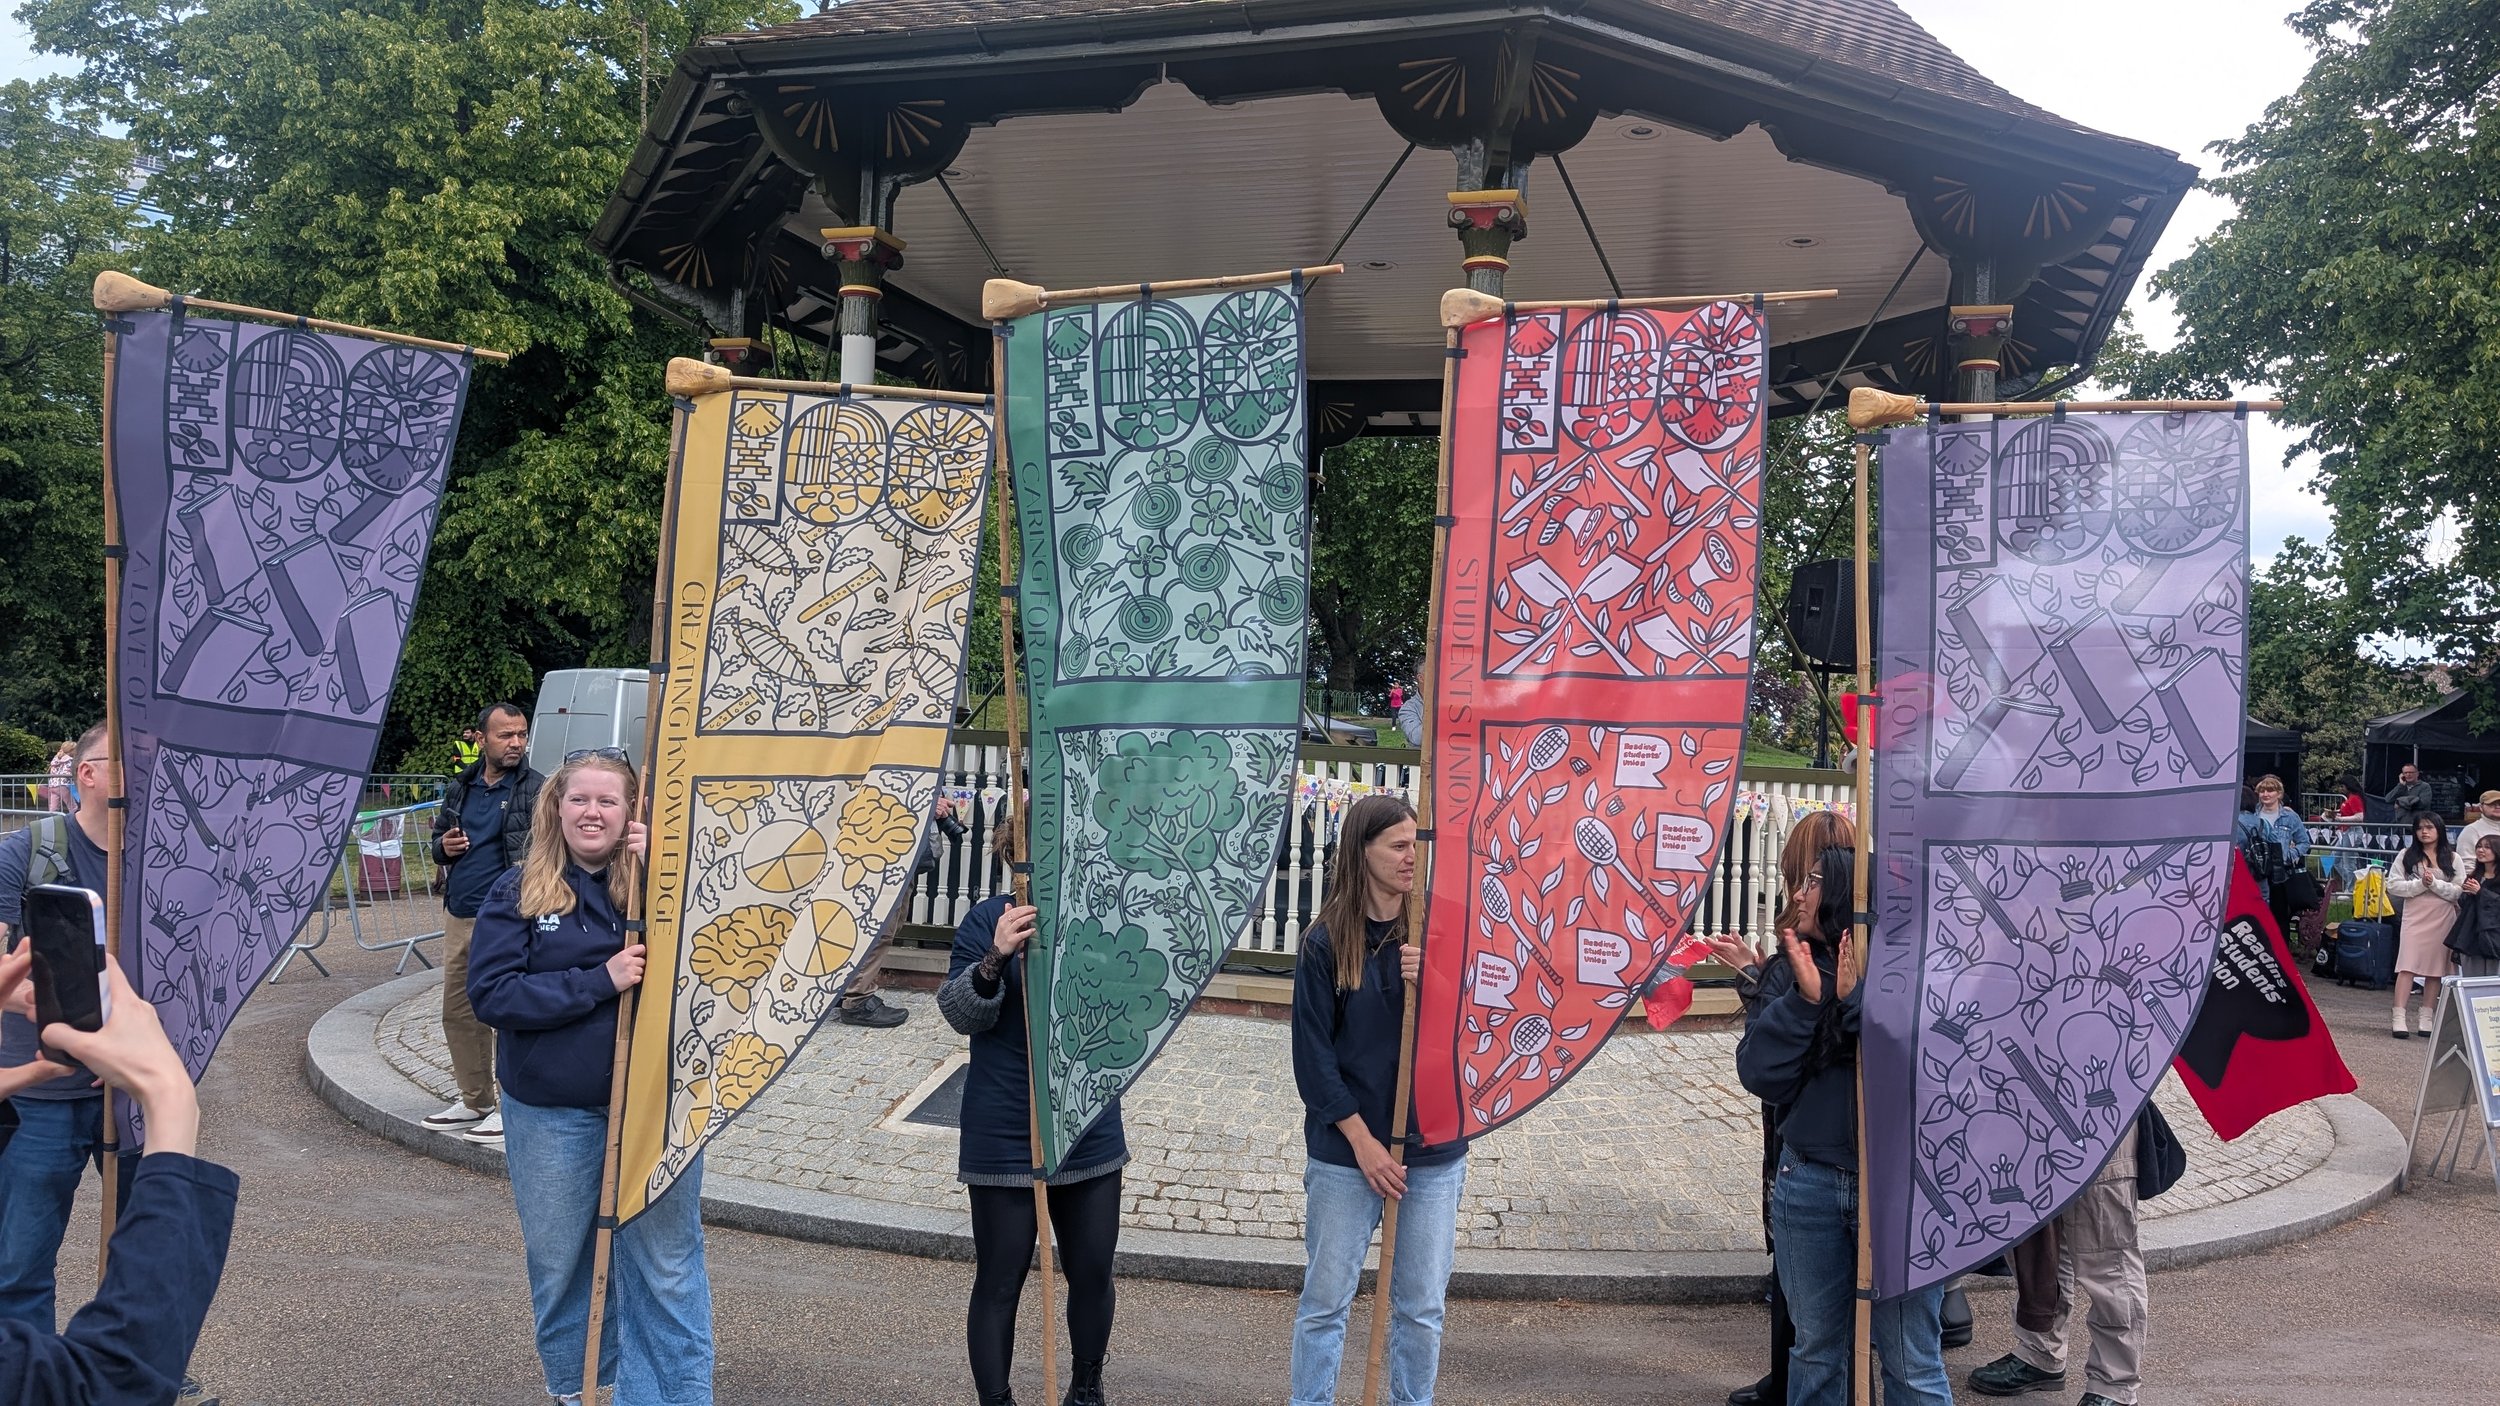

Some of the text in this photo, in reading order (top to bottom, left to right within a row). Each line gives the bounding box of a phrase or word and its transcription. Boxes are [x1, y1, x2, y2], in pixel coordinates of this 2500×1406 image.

[1021, 461, 1049, 582] CARING
[132, 550, 151, 573] A
[127, 582, 149, 669] LOVE
[1026, 591, 1051, 648] FOR
[127, 676, 147, 720] OF
[1447, 558, 1480, 826] STUDENTS UNION
[653, 581, 707, 936] CREATING KNOWLEDGE
[1624, 743, 1657, 751] Reading
[1662, 824, 1698, 835] Reading
[1879, 656, 1919, 994] A LOVE OF LEARNING
[1662, 842, 1687, 850] Union
[1583, 938, 1617, 950] Reading
[2231, 921, 2287, 988] Reading
[1481, 961, 1507, 974] Reading
[1583, 956, 1607, 965] Union
[2212, 958, 2240, 990] ion
[1480, 978, 1498, 988] Union
